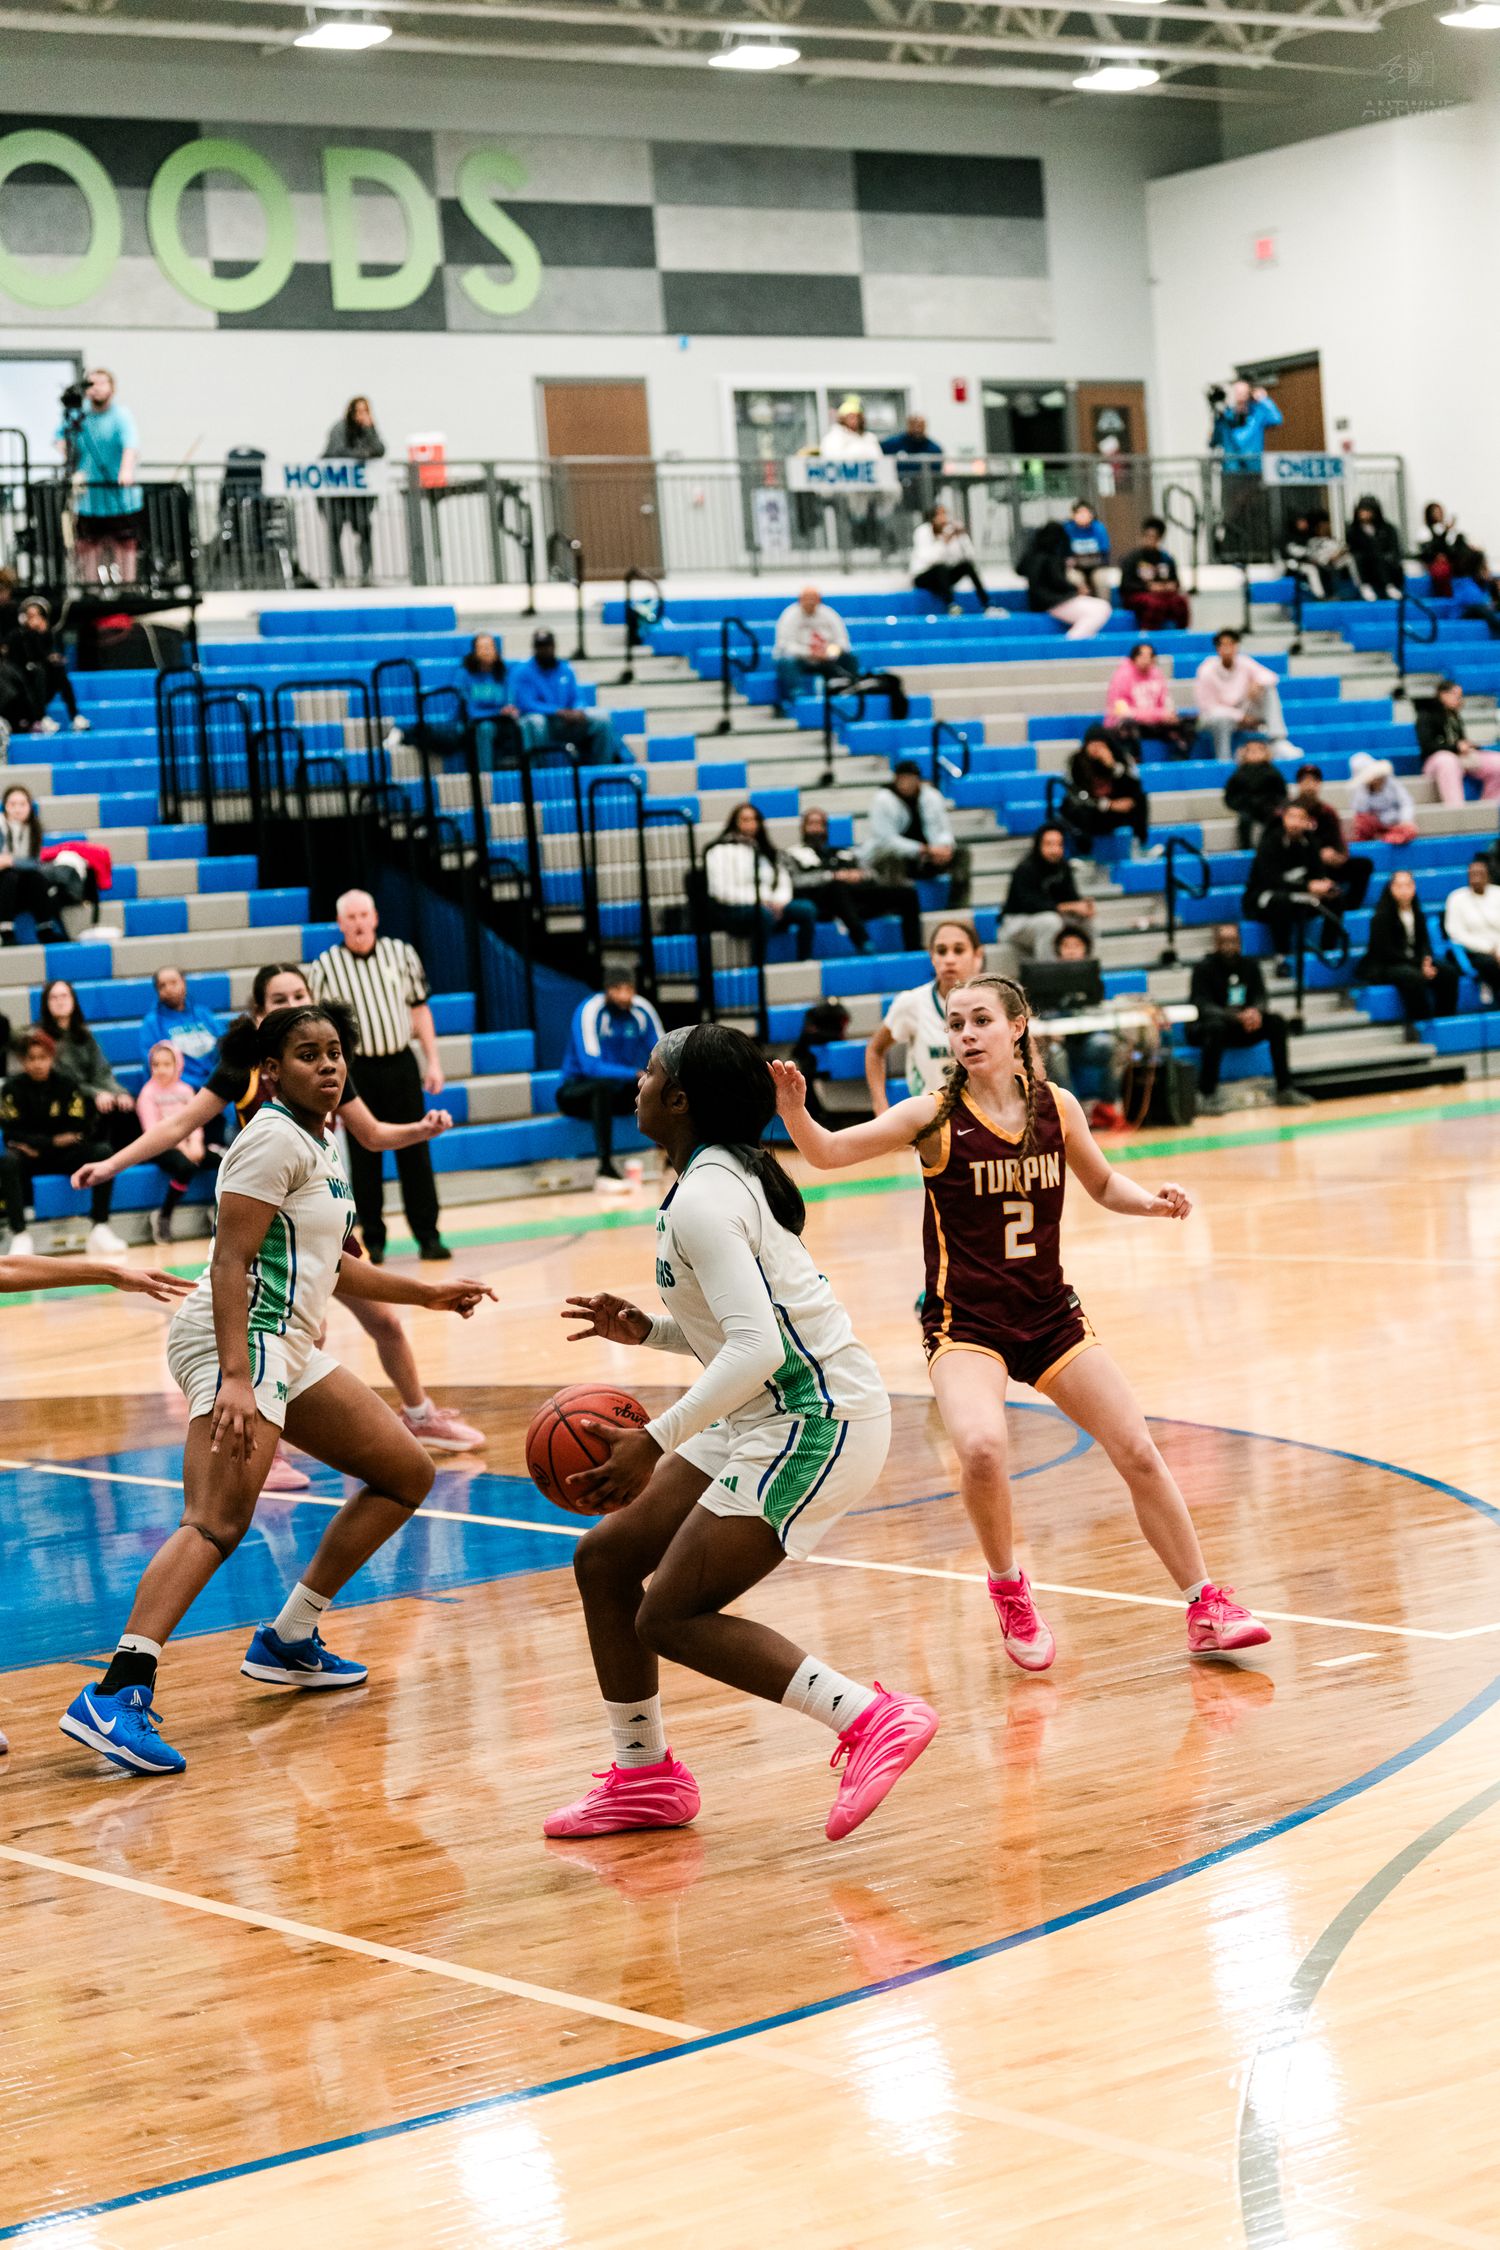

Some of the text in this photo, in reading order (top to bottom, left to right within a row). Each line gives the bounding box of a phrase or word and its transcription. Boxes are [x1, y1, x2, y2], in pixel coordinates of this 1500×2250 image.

[0, 128, 543, 316] OODS
[284, 464, 368, 489] HOME
[806, 460, 876, 484] HOME
[969, 1151, 1061, 1196] TURPIN
[1003, 1200, 1037, 1260] 2
